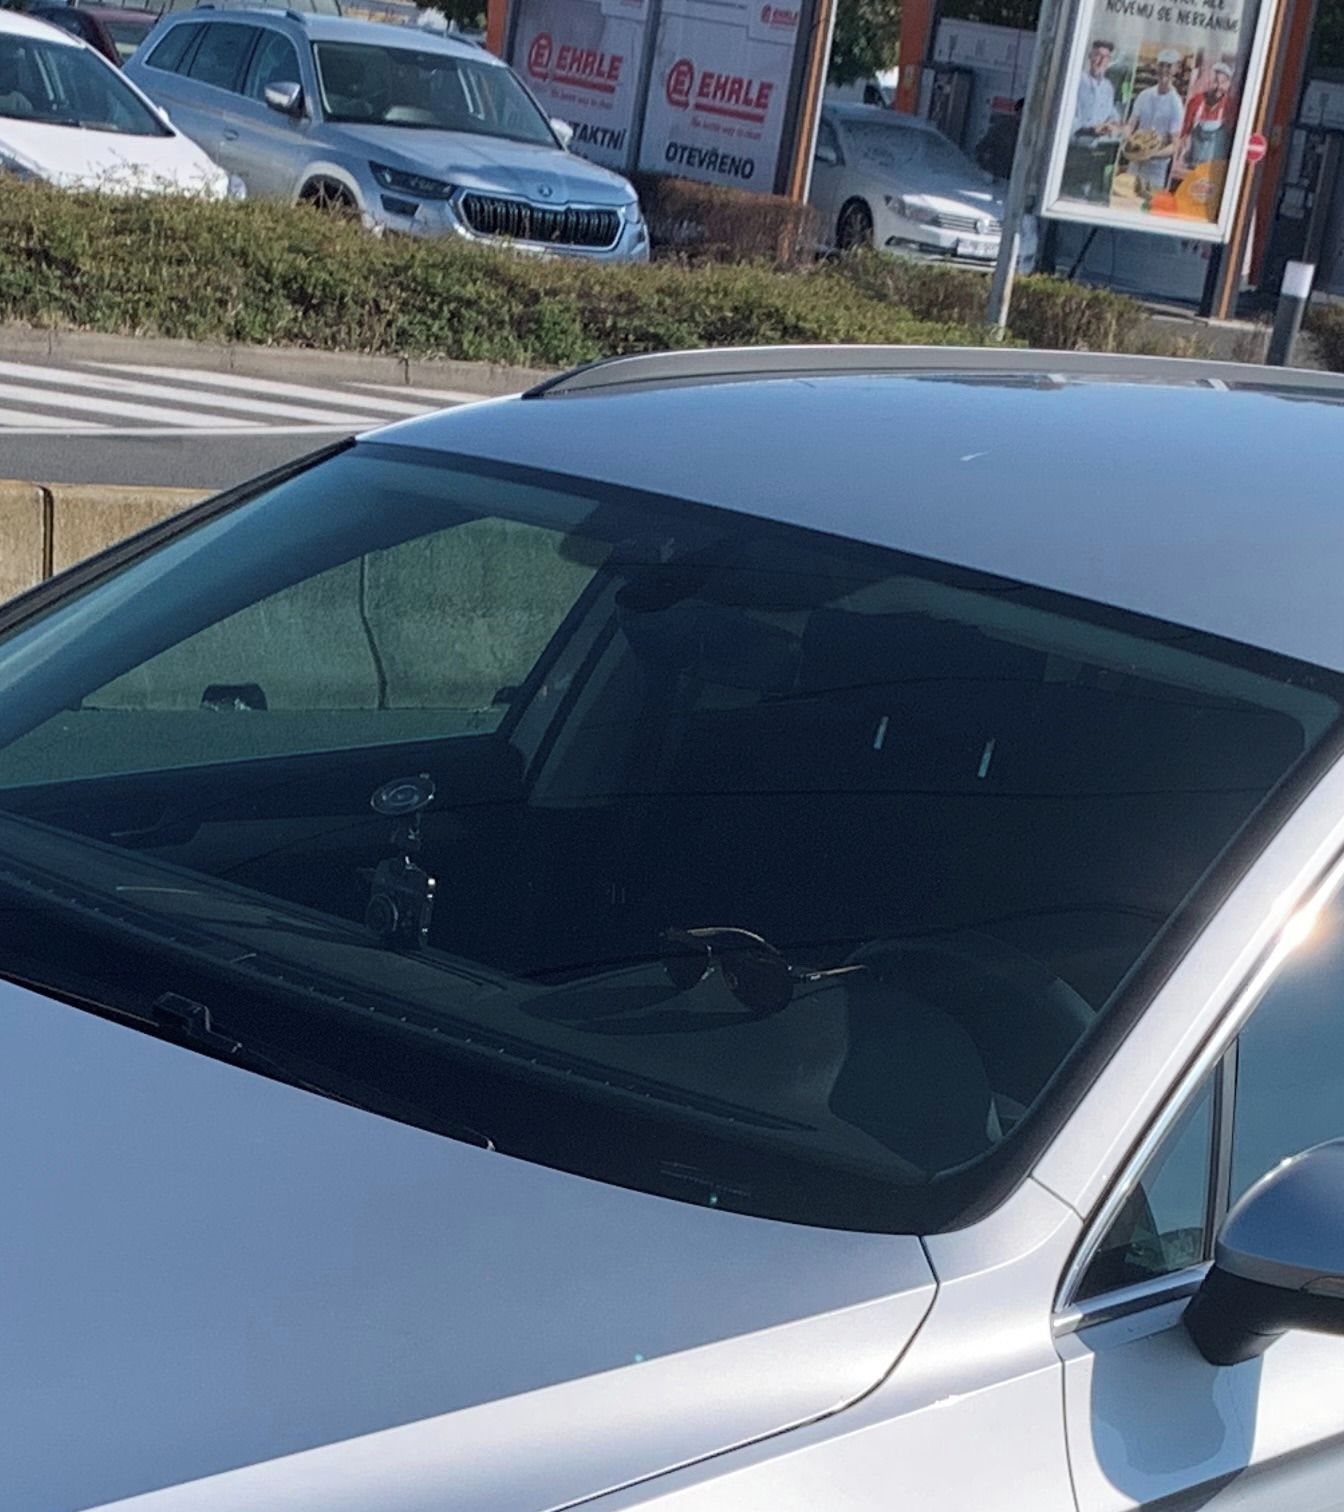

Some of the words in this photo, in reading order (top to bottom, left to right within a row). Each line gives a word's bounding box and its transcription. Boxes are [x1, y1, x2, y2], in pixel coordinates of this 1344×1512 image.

[556, 45, 624, 81] EHRLE
[698, 71, 774, 109] EHRLE
[568, 120, 627, 150] TAKTNÍ
[665, 141, 755, 181] OTEVŘENO
